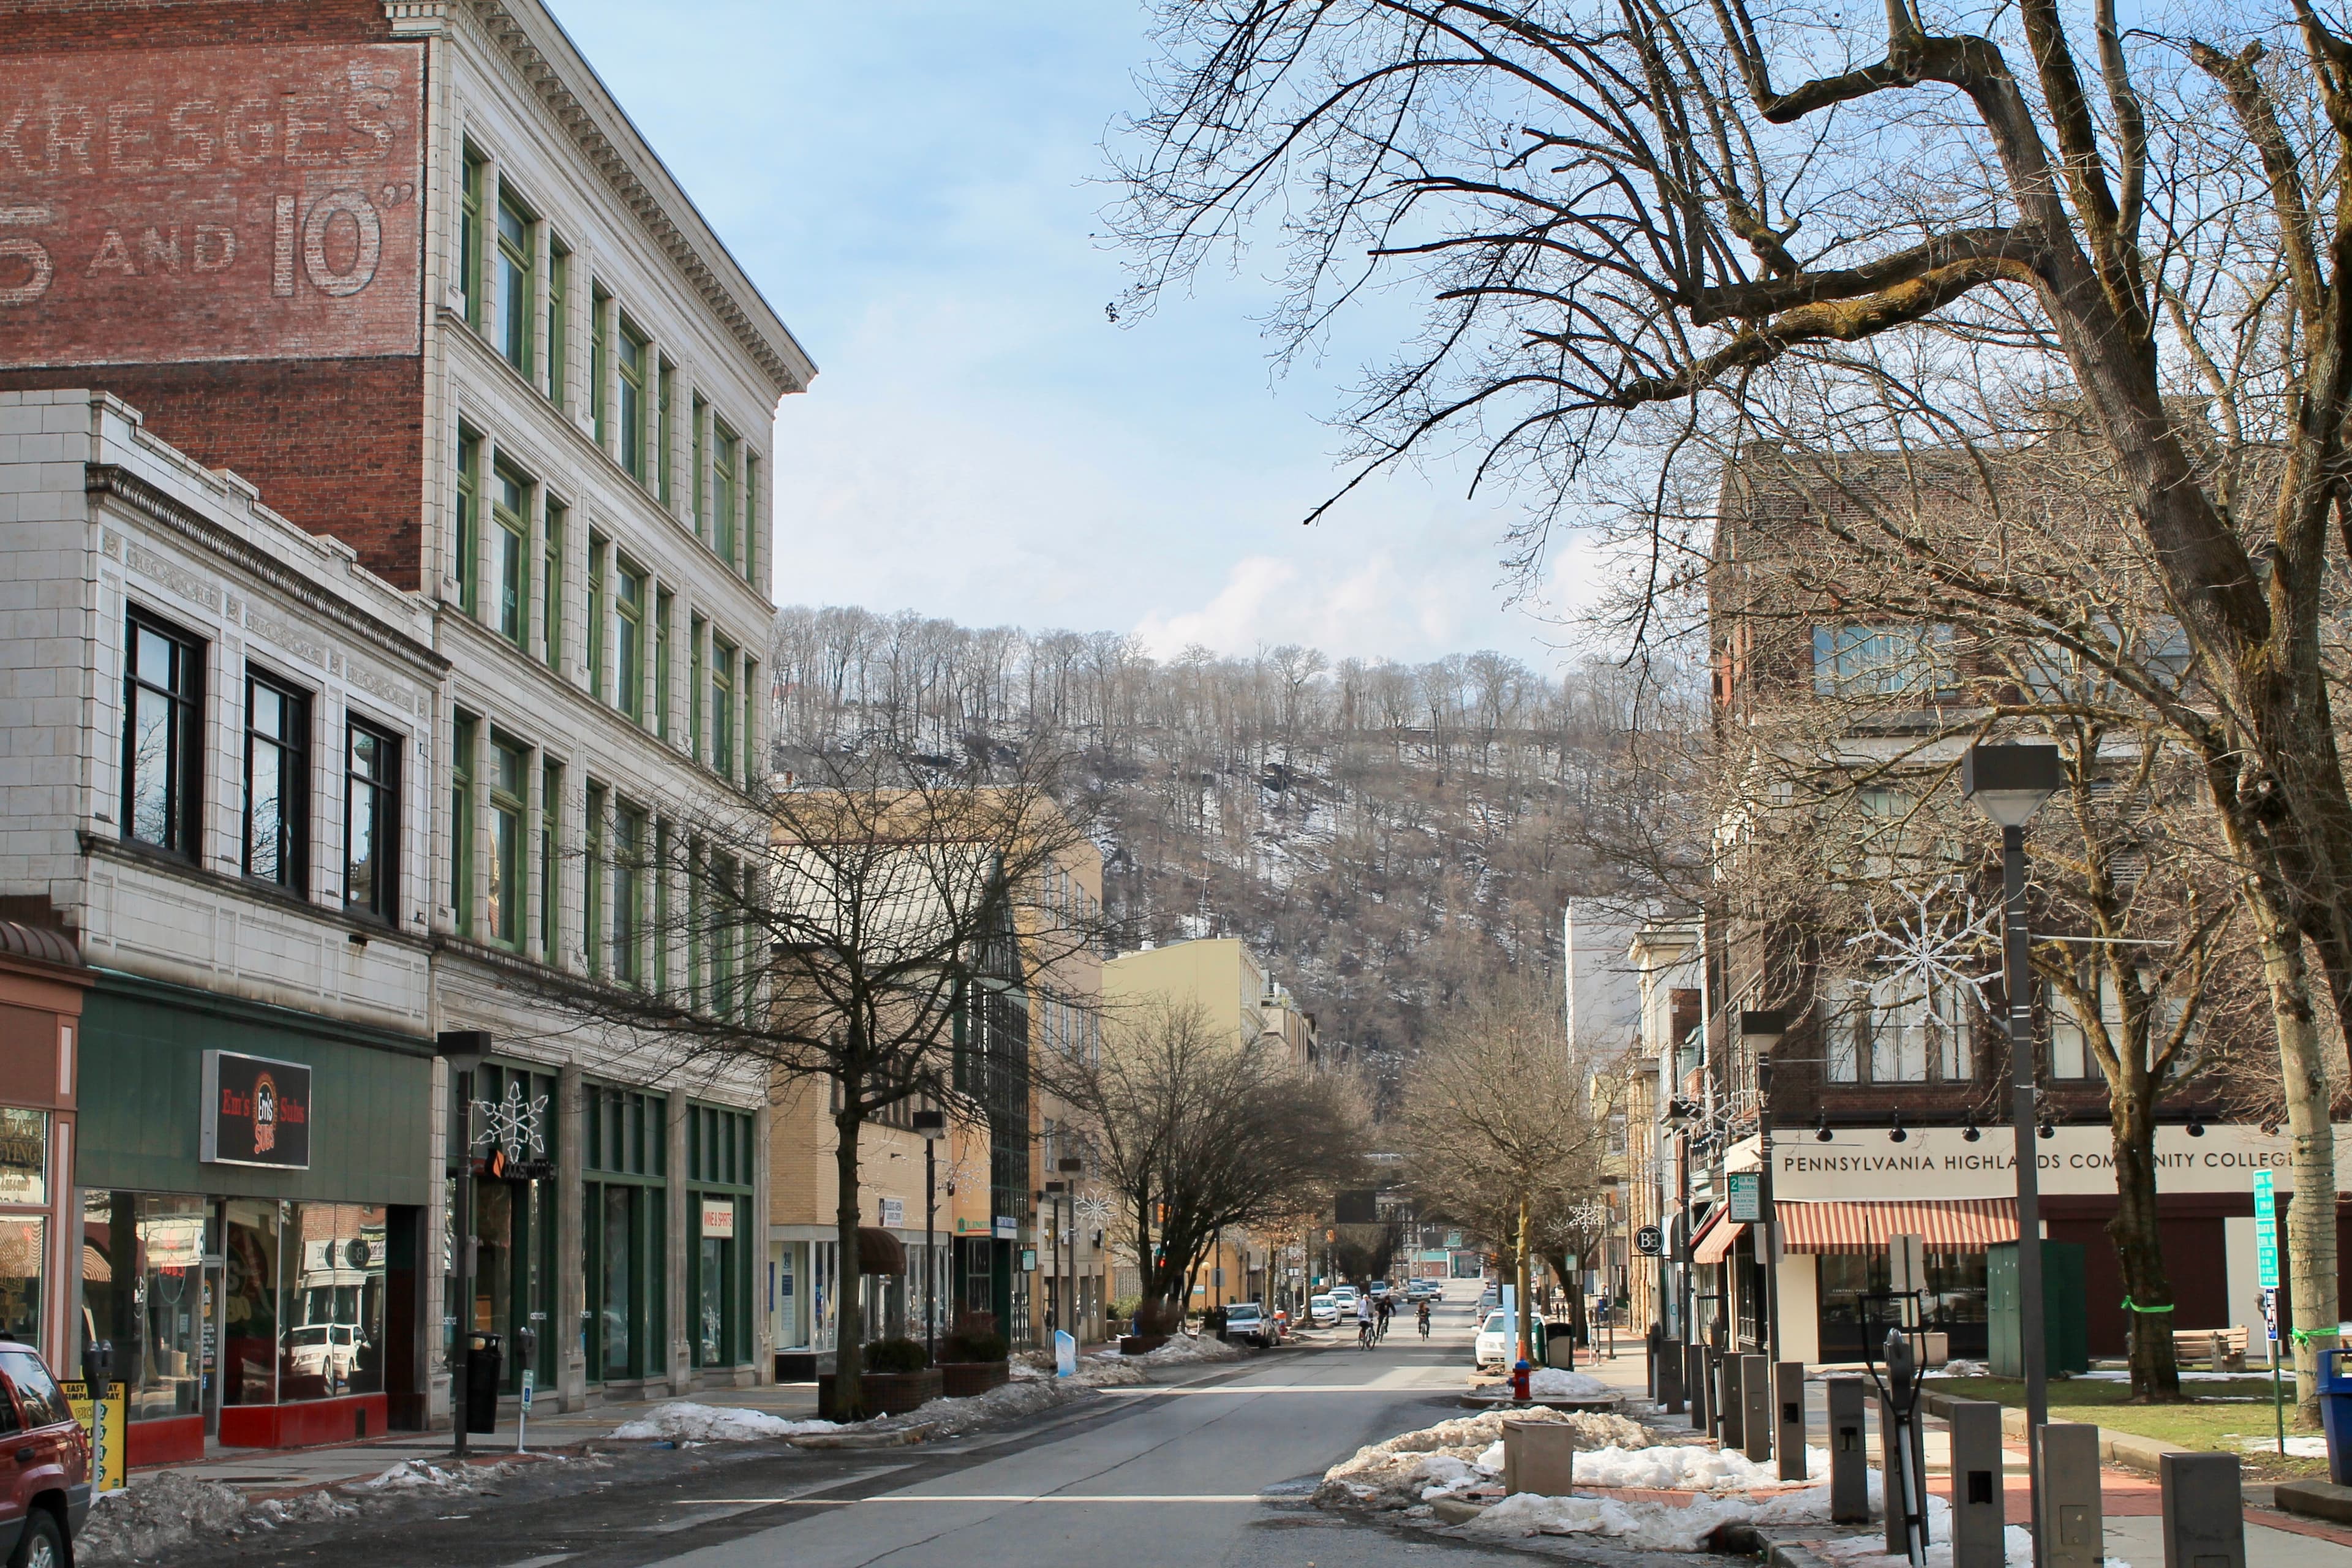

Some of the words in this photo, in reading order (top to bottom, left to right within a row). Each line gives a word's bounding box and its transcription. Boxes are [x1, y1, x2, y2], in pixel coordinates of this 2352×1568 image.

[82, 223, 238, 279] AND
[222, 1088, 251, 1117] Em's
[280, 1097, 305, 1125] Subs
[257, 1092, 273, 1122] Em's
[0, 1118, 40, 1139] WAYS
[0, 1140, 43, 1163] YING!
[1784, 1156, 1935, 1172] PENNSYLVANIA
[1945, 1155, 2060, 1170] HIGHLADS
[2070, 1153, 2195, 1169] COMNITY
[1730, 1178, 1738, 1189] 2
[704, 1212, 714, 1226] WINE
[718, 1212, 732, 1227] SPIRITS
[66, 1384, 85, 1393] EASY
[75, 1406, 92, 1420] PIC
